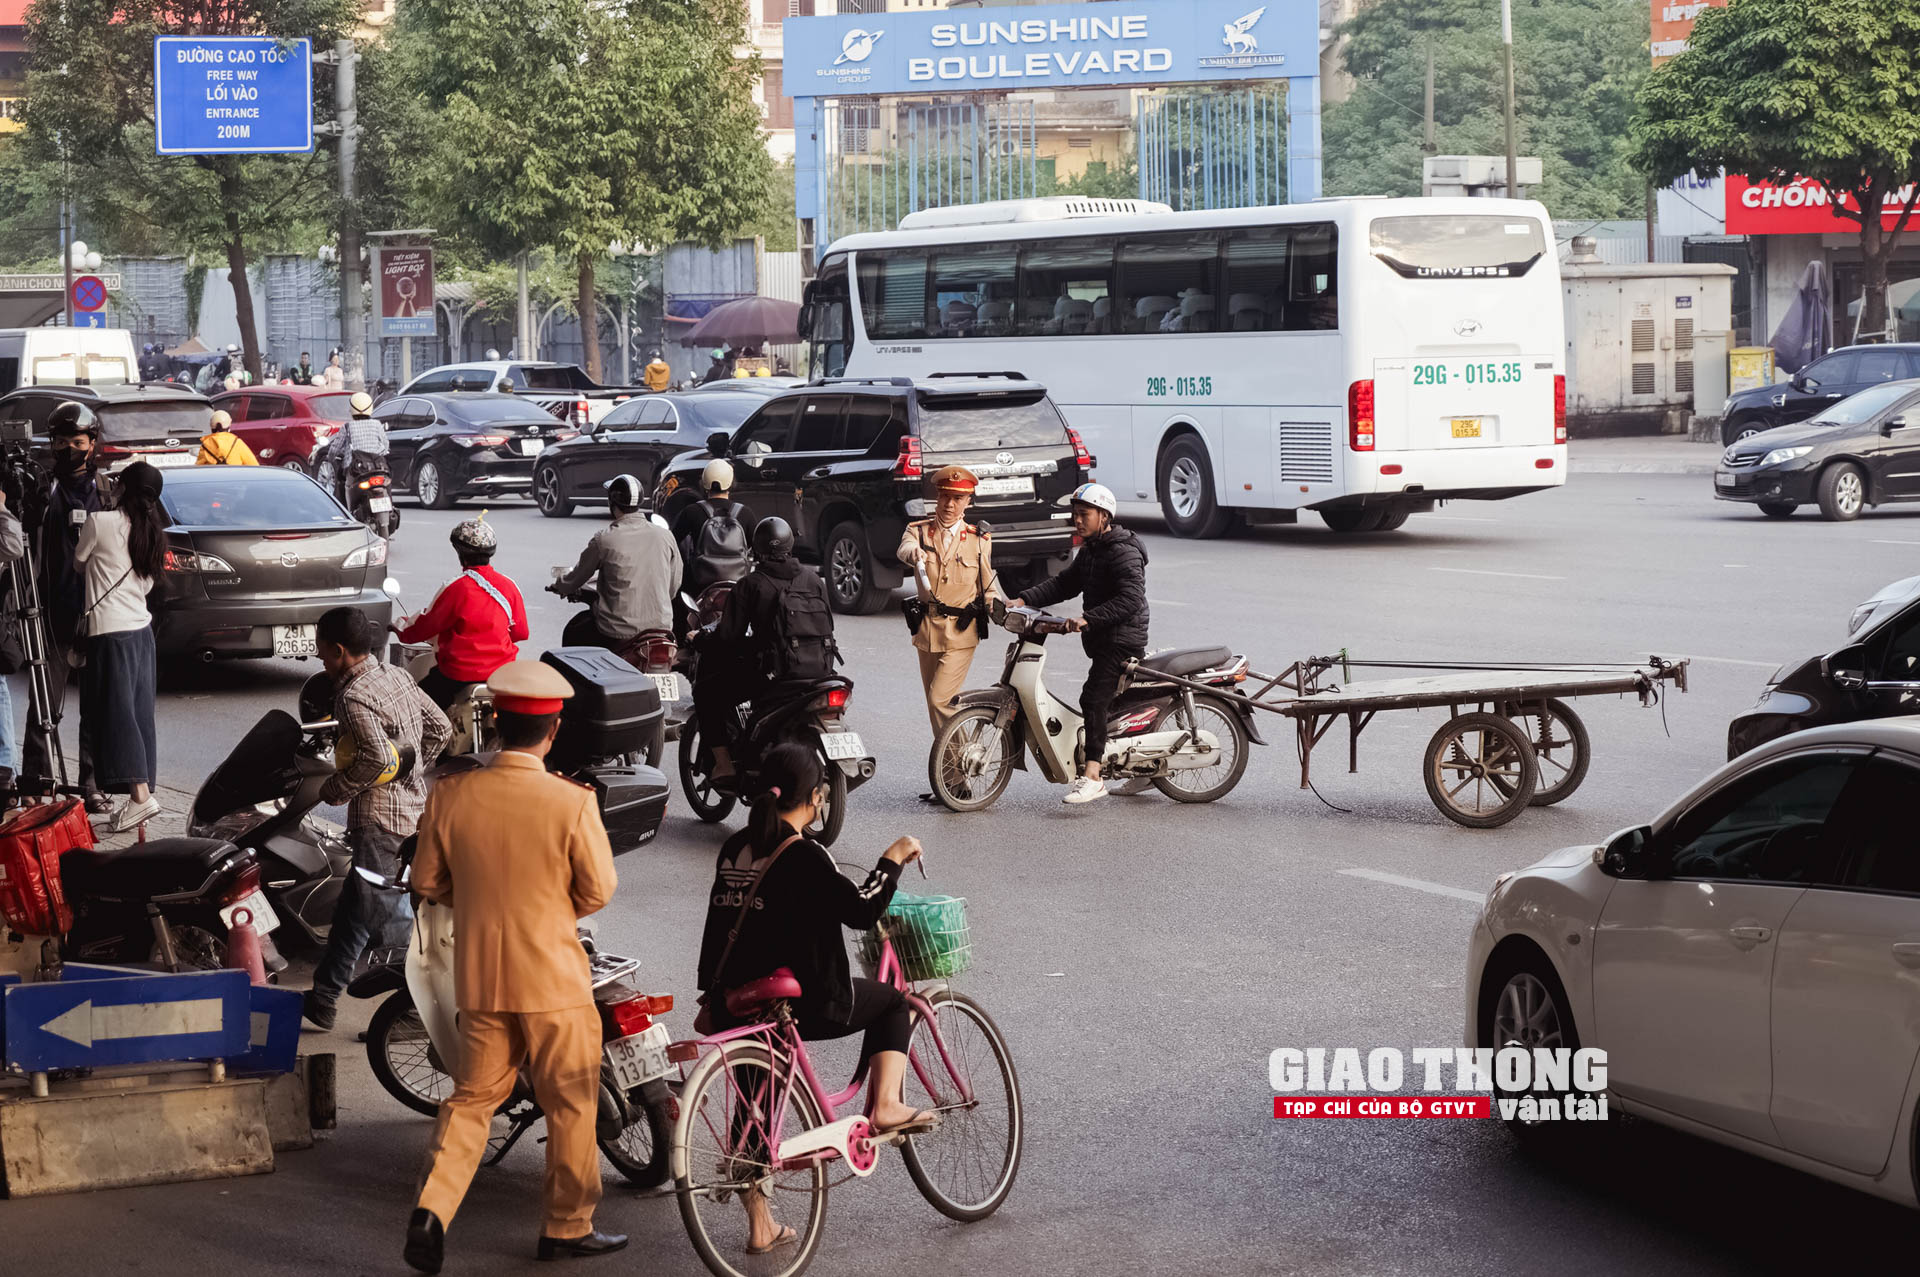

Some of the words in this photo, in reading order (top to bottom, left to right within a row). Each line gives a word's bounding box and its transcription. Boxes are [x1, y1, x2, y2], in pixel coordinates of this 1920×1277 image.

[931, 15, 1148, 47] SUNSHINE
[177, 46, 224, 63] ĐƯỜNG
[228, 50, 256, 63] CAO
[260, 46, 287, 63] TỐC
[908, 48, 1172, 81] BOULEVARD
[207, 70, 233, 80] FREE
[237, 70, 258, 80] WAY
[816, 67, 871, 76] SUNSHINE
[206, 83, 228, 100] LỐI
[232, 84, 258, 100] VÀO
[206, 108, 259, 118] ENTRANCE
[217, 125, 250, 138] 200M
[385, 265, 407, 275] LIGHT
[408, 264, 425, 273] BOX
[1417, 266, 1510, 276] UNIVERSE
[29, 279, 52, 289] CHO
[1414, 364, 1447, 385] 29G
[1466, 363, 1522, 383] 015.35
[1147, 377, 1167, 396] 29G
[1176, 376, 1212, 396] 015.35
[1460, 420, 1473, 428] 29G
[1455, 429, 1479, 437] 015.35
[284, 625, 306, 639] 29A
[713, 890, 765, 910] adids
